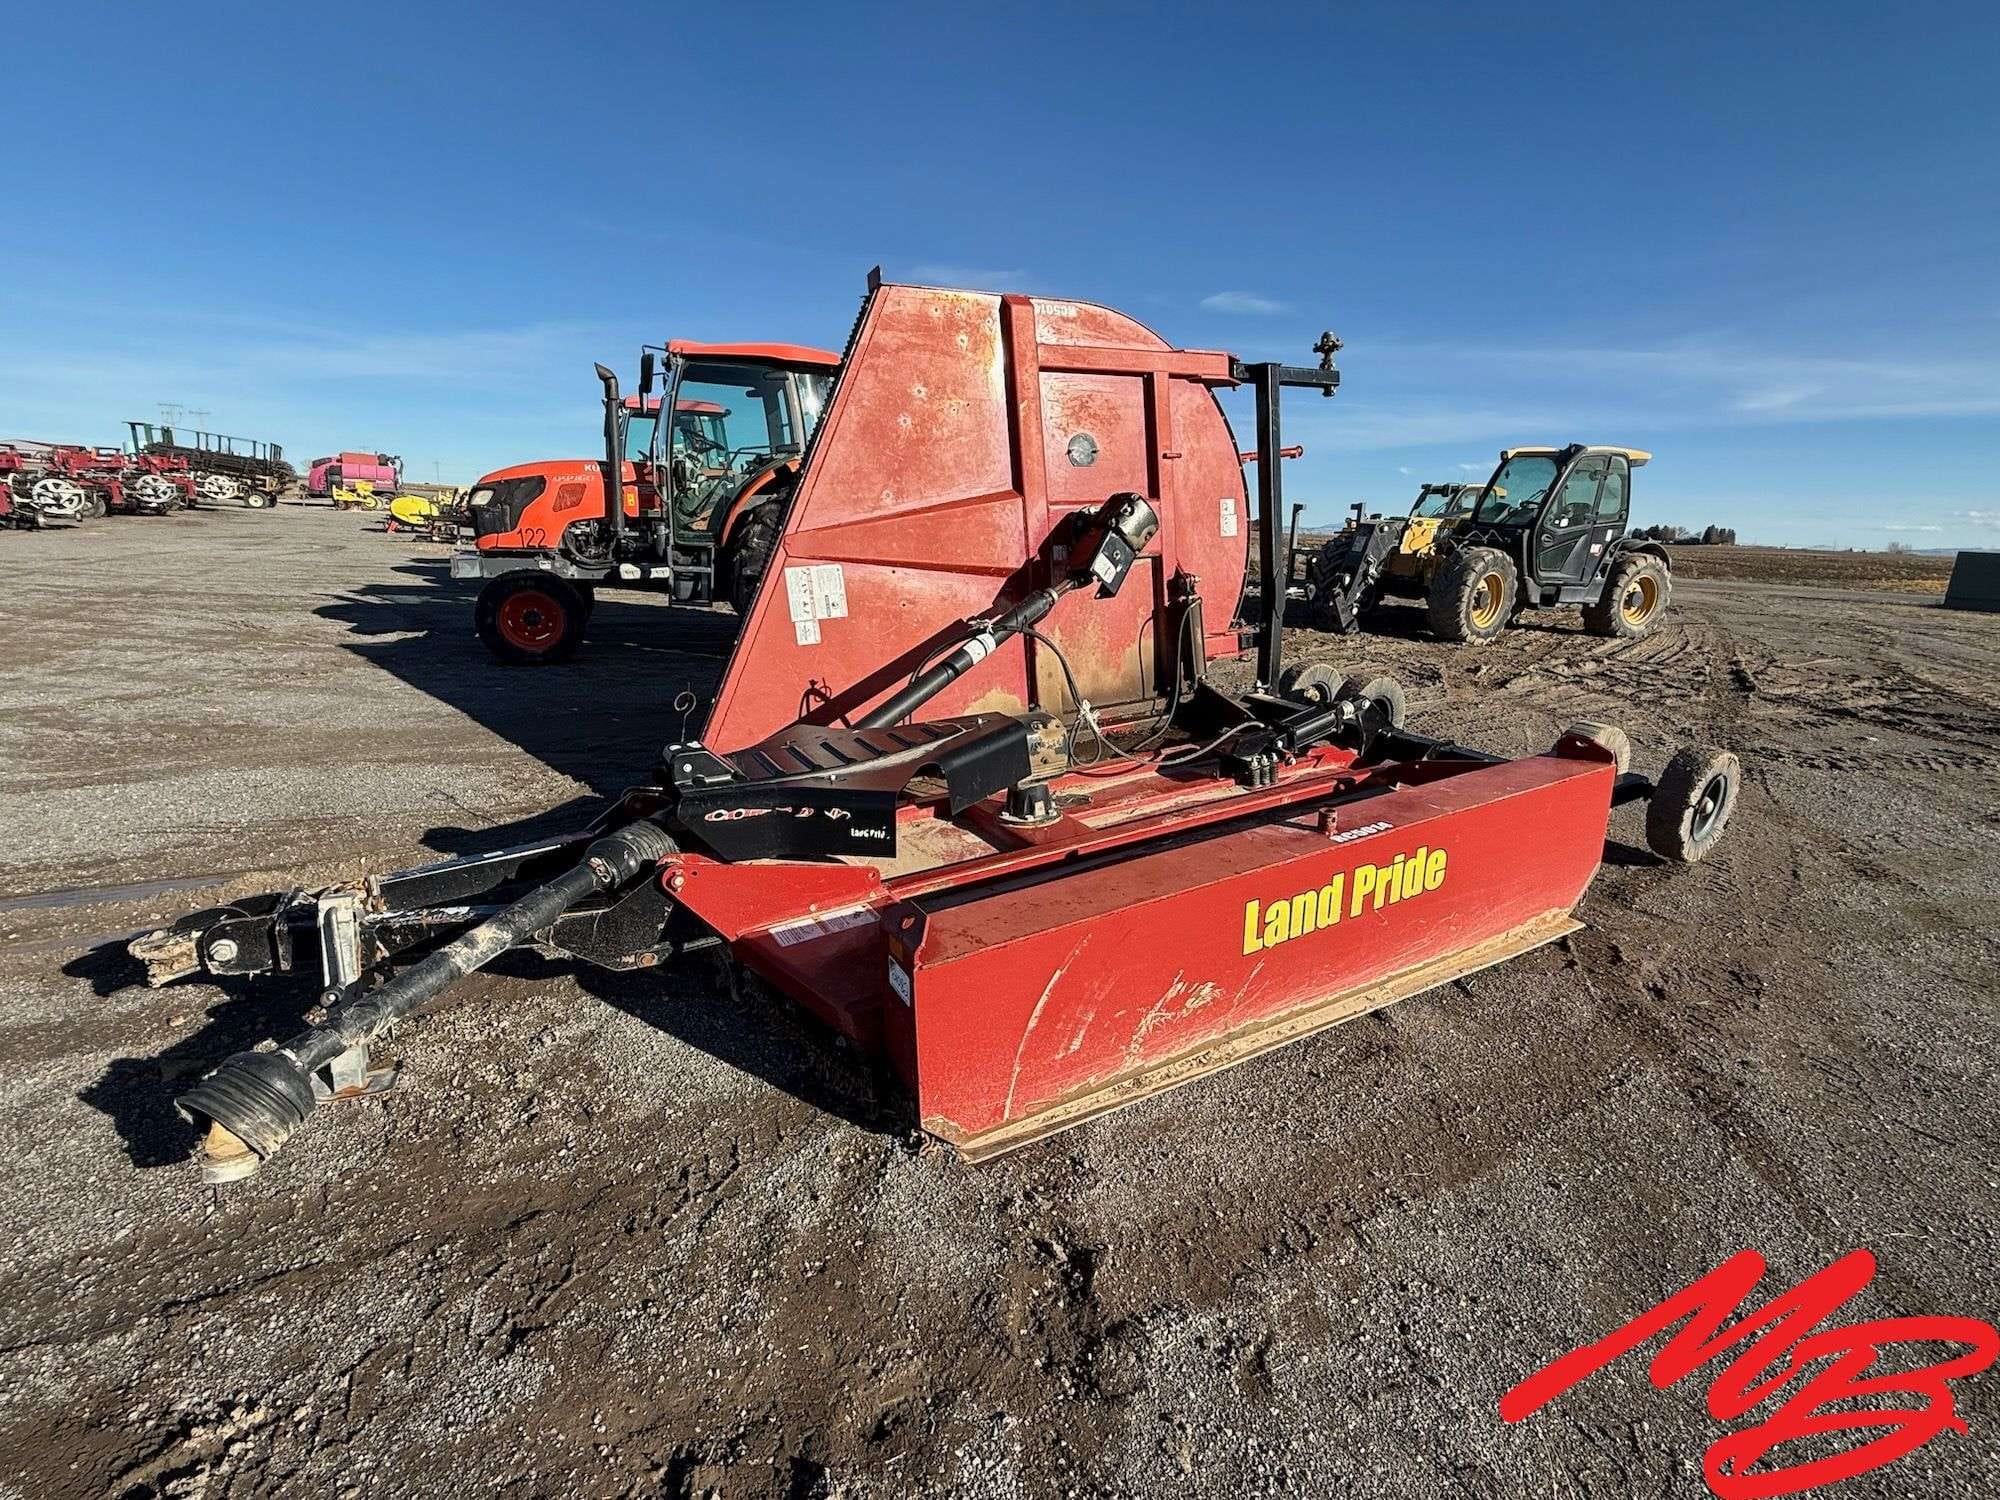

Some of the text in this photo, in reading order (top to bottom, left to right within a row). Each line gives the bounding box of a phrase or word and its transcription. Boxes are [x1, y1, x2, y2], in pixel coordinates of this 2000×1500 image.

[516, 527, 548, 548] 122
[1242, 845, 1448, 956] Land Pride
